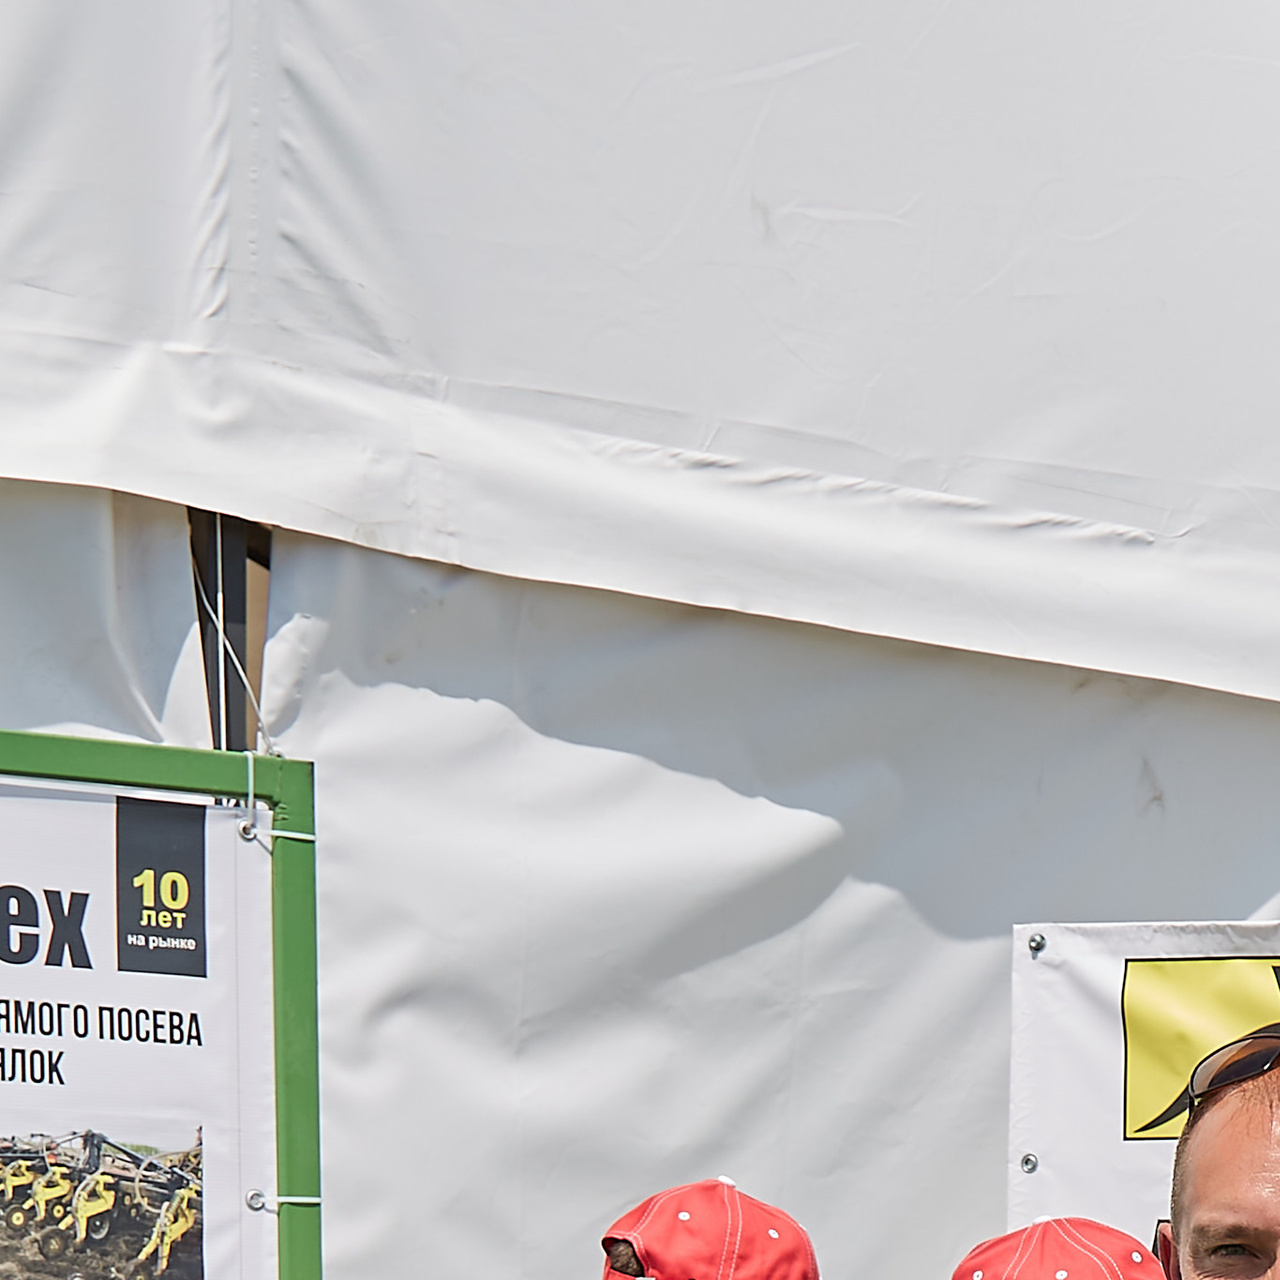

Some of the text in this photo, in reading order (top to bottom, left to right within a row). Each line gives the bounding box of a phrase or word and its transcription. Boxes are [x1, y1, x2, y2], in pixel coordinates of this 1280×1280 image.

[132, 868, 190, 910] 10
[139, 909, 187, 929] лет
[127, 933, 197, 951] на рынке
[98, 1005, 203, 1047] ПОСЕВА
